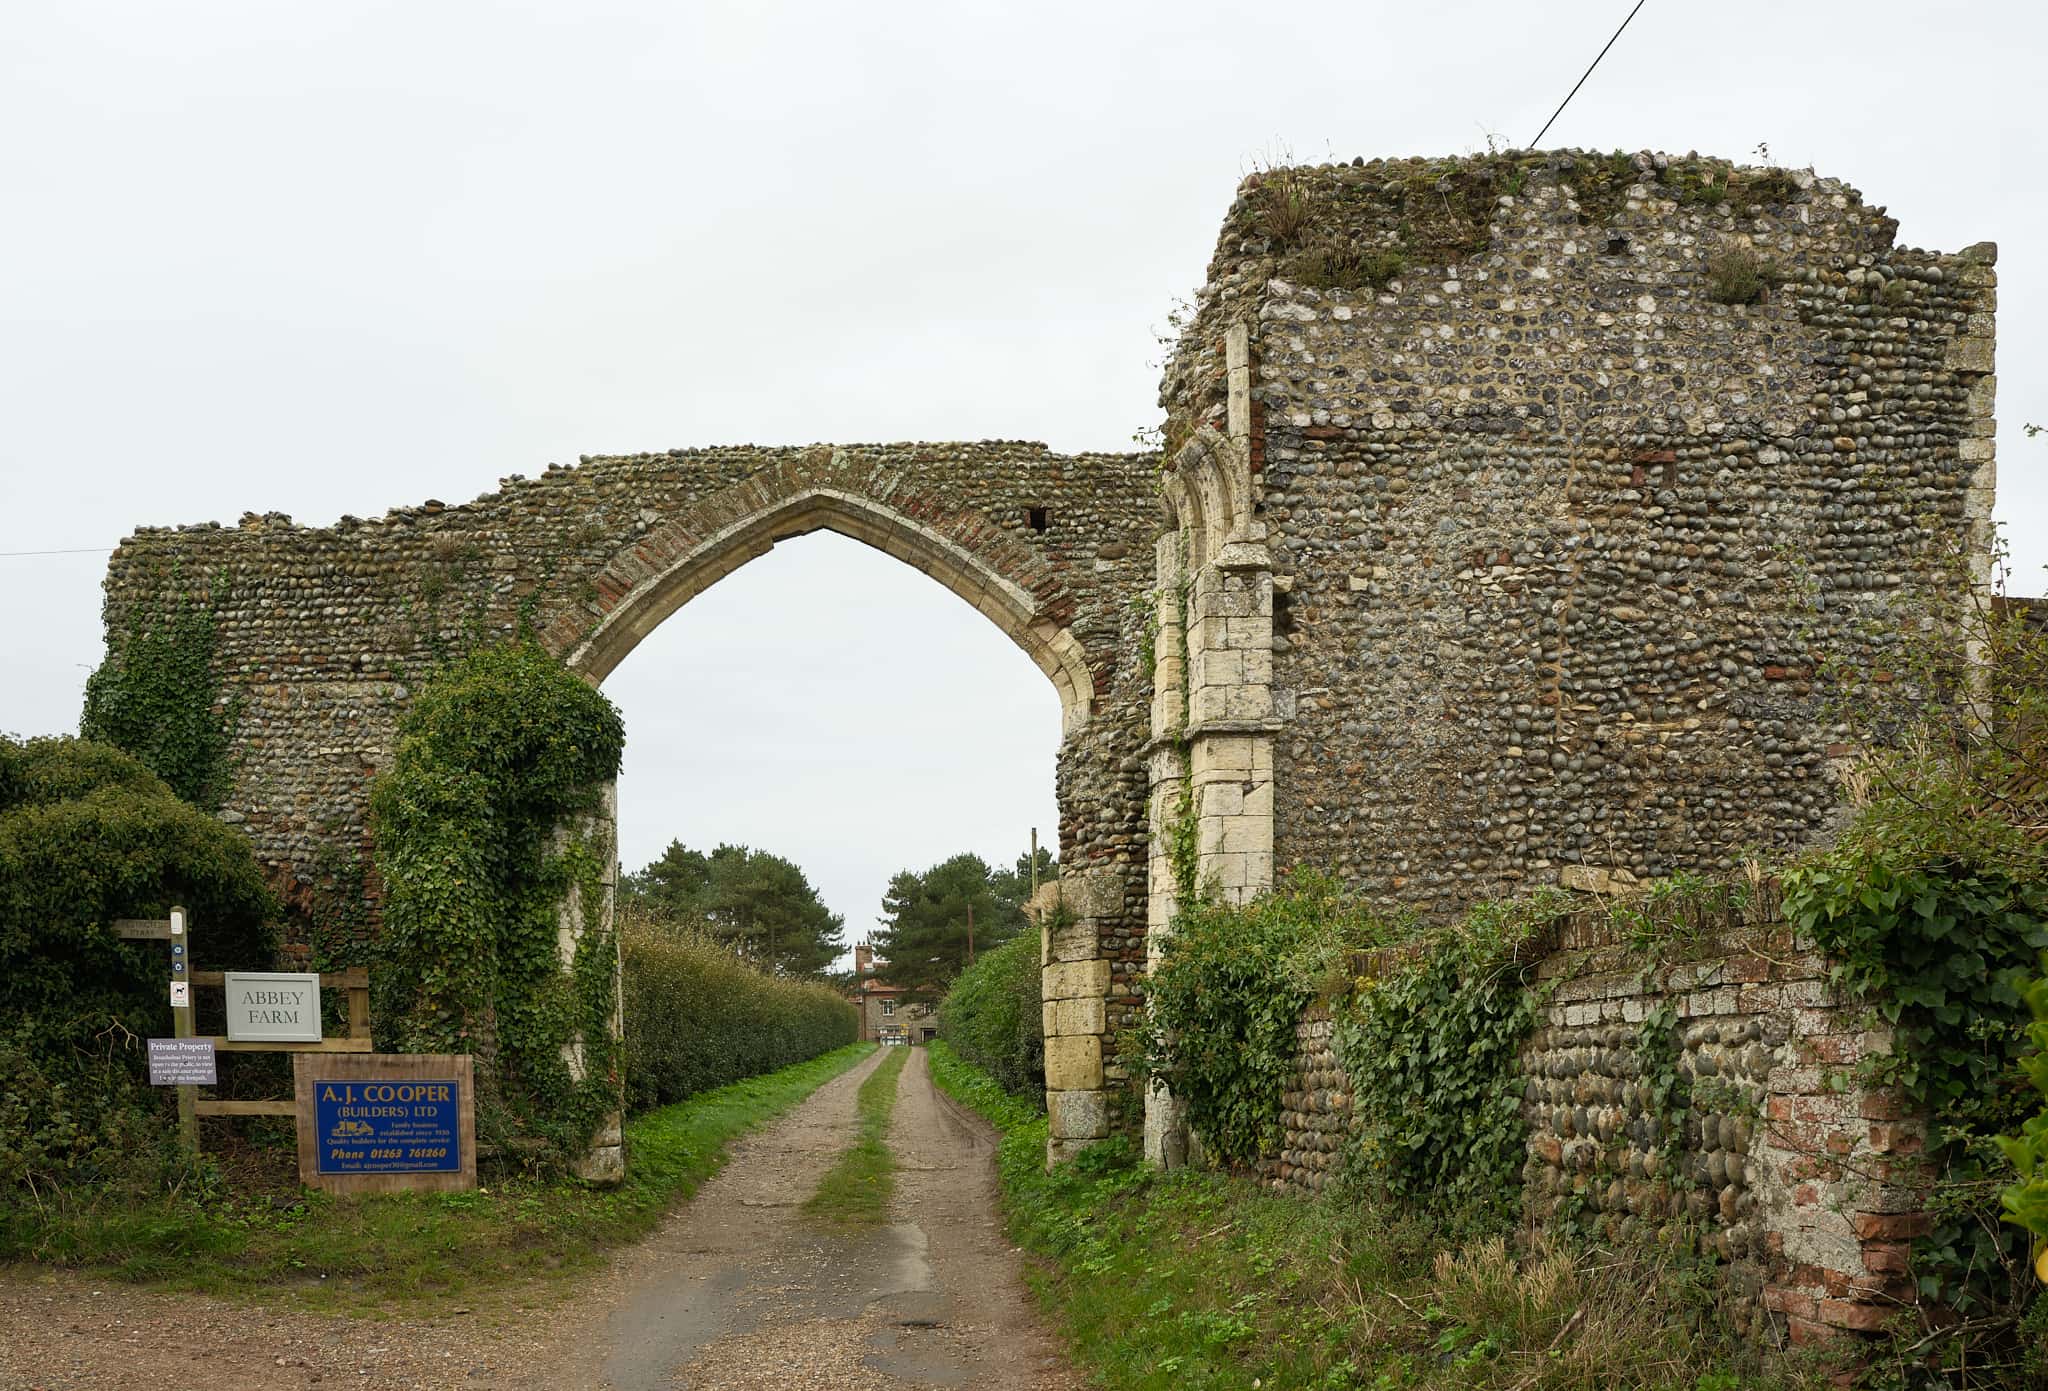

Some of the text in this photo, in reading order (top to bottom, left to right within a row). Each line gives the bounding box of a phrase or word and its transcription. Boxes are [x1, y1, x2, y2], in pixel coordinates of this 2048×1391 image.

[241, 991, 304, 1006] ABBEY
[248, 1010, 302, 1024] FARM
[151, 1042, 212, 1053] Private Property
[322, 1085, 450, 1104] A.J. COOPER
[337, 1106, 438, 1118] (BUILDERS) LTD
[331, 1147, 447, 1159] Phone 01263 761260
